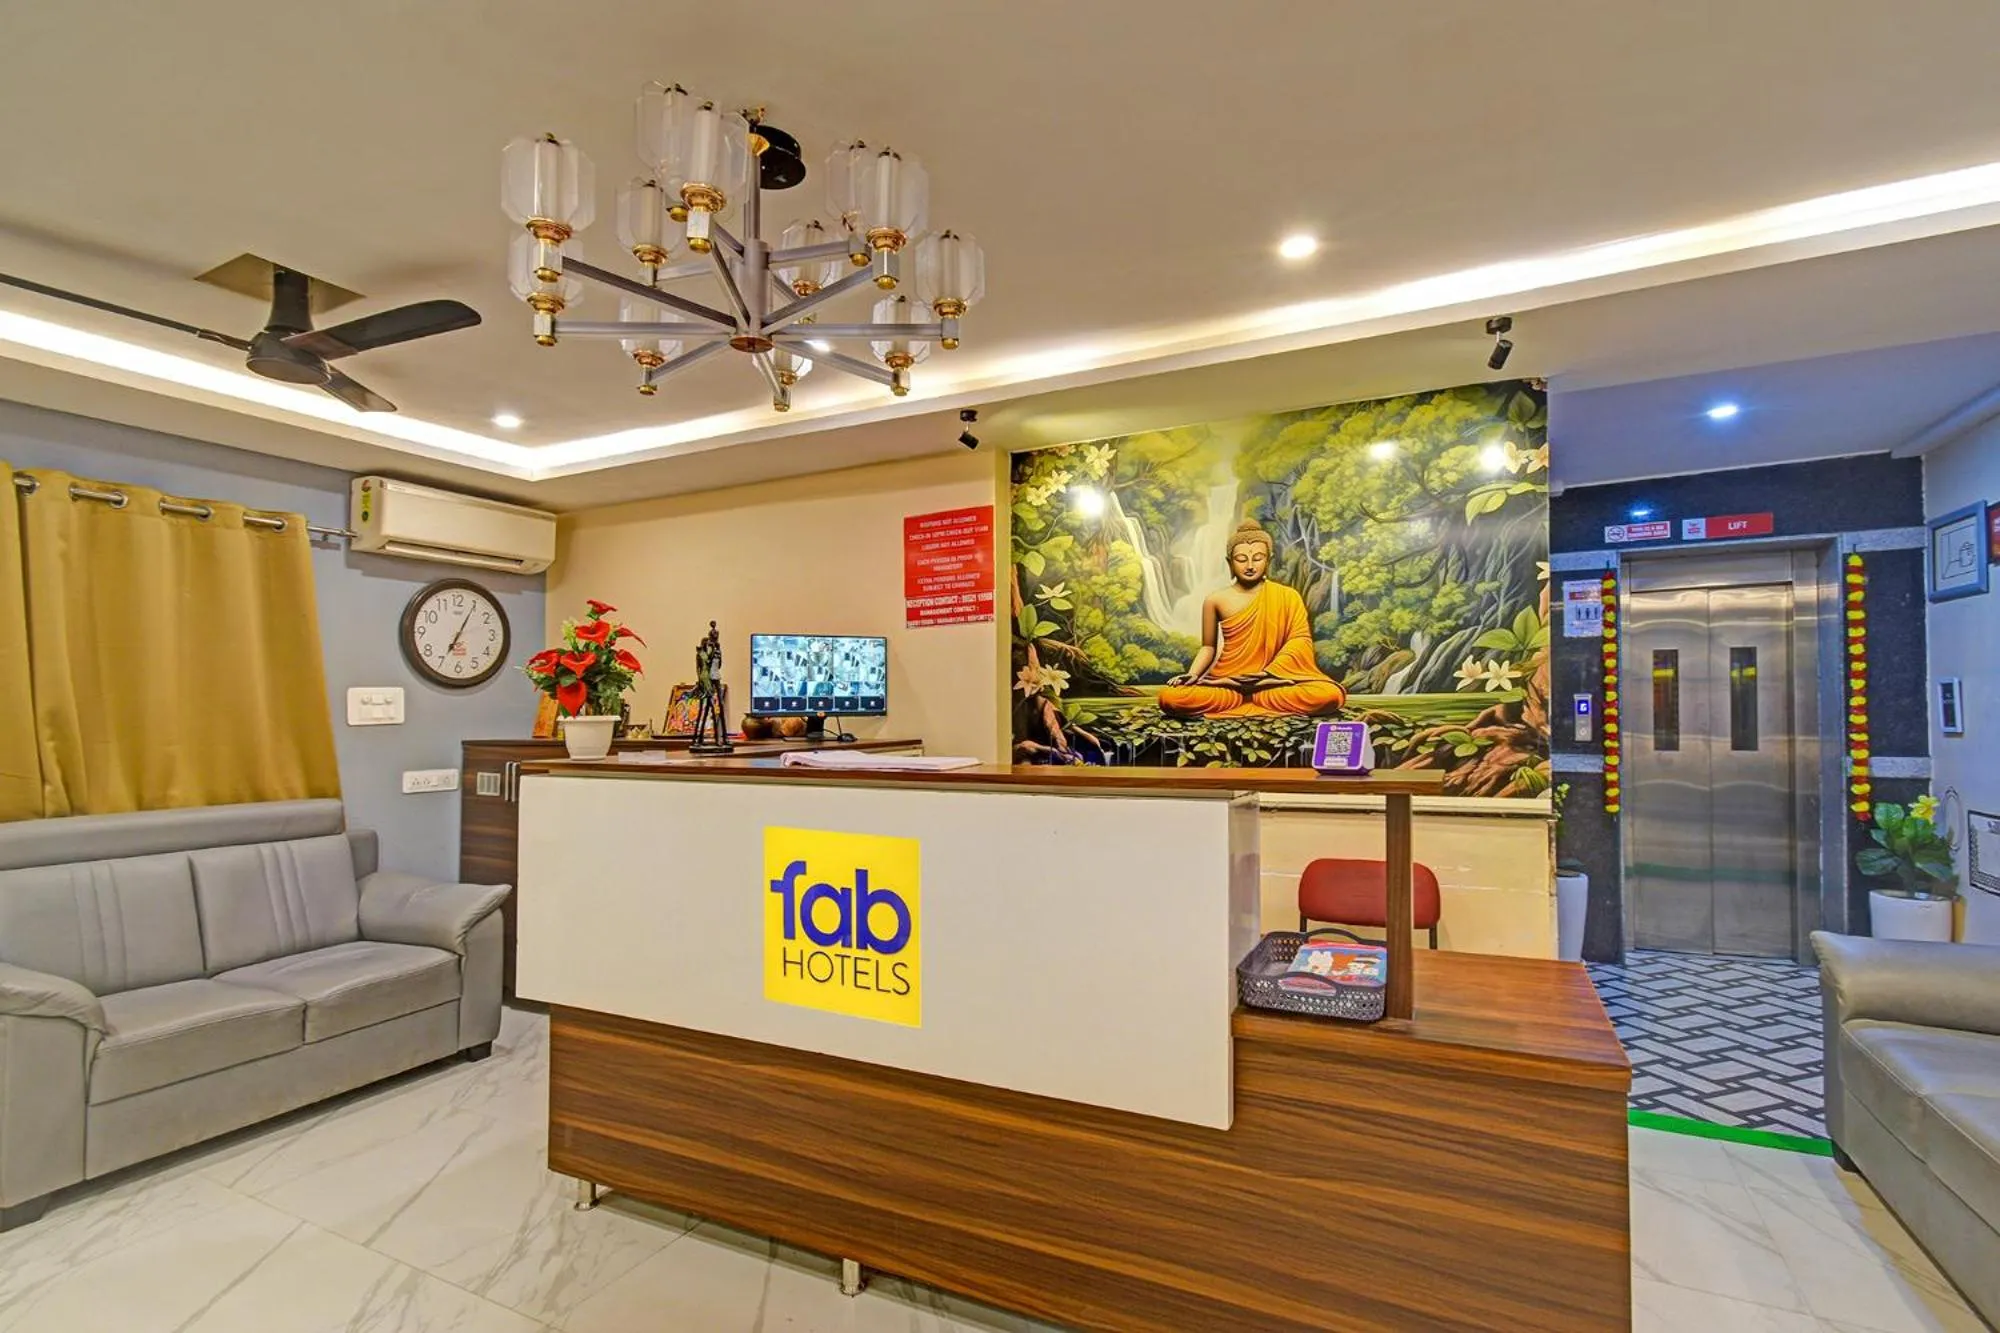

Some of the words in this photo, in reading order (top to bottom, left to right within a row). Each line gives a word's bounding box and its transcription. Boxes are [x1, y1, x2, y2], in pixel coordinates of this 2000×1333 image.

[1727, 520, 1748, 531] LIFT
[436, 598, 448, 611] 11
[451, 594, 464, 607] 12
[423, 610, 438, 624] 10
[482, 612, 490, 625] 2
[417, 626, 426, 640] 9
[488, 629, 496, 642] 3
[423, 644, 433, 657] 8
[482, 646, 490, 657] 4
[438, 655, 446, 669] 7
[454, 661, 463, 673] 6
[471, 657, 479, 669] 5
[770, 860, 912, 956] fab
[783, 946, 911, 996] HOTELS
